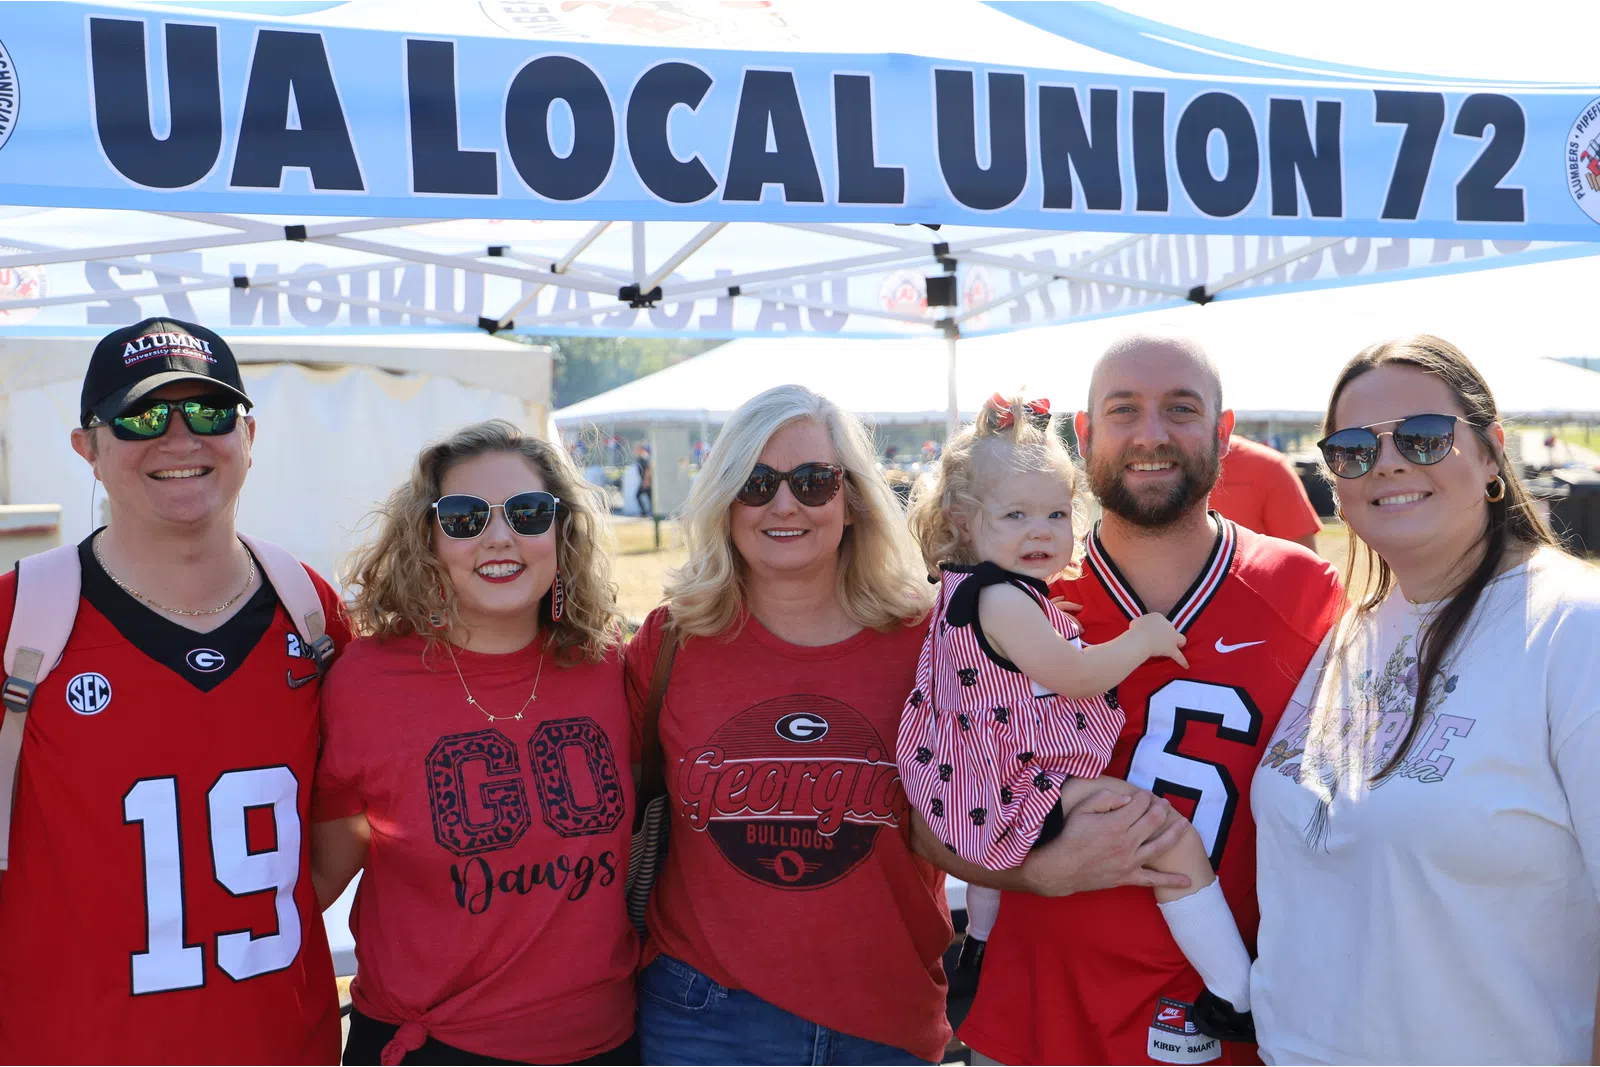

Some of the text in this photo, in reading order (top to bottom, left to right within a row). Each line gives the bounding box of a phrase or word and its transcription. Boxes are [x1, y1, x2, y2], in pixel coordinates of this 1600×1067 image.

[89, 16, 1526, 223] UA LOCAL UNION 72
[1569, 141, 1586, 200] PLUMBERS
[123, 333, 213, 358] ALUMNI
[125, 348, 169, 365] University
[70, 675, 109, 711] SEC
[425, 716, 626, 857] GO
[678, 745, 906, 837] Georgia
[1124, 678, 1264, 873] 6
[746, 823, 834, 851] BULLDOGS
[122, 764, 302, 997] 19
[450, 851, 620, 915] Dawgs
[1153, 1039, 1216, 1053] KIRBY SMART
